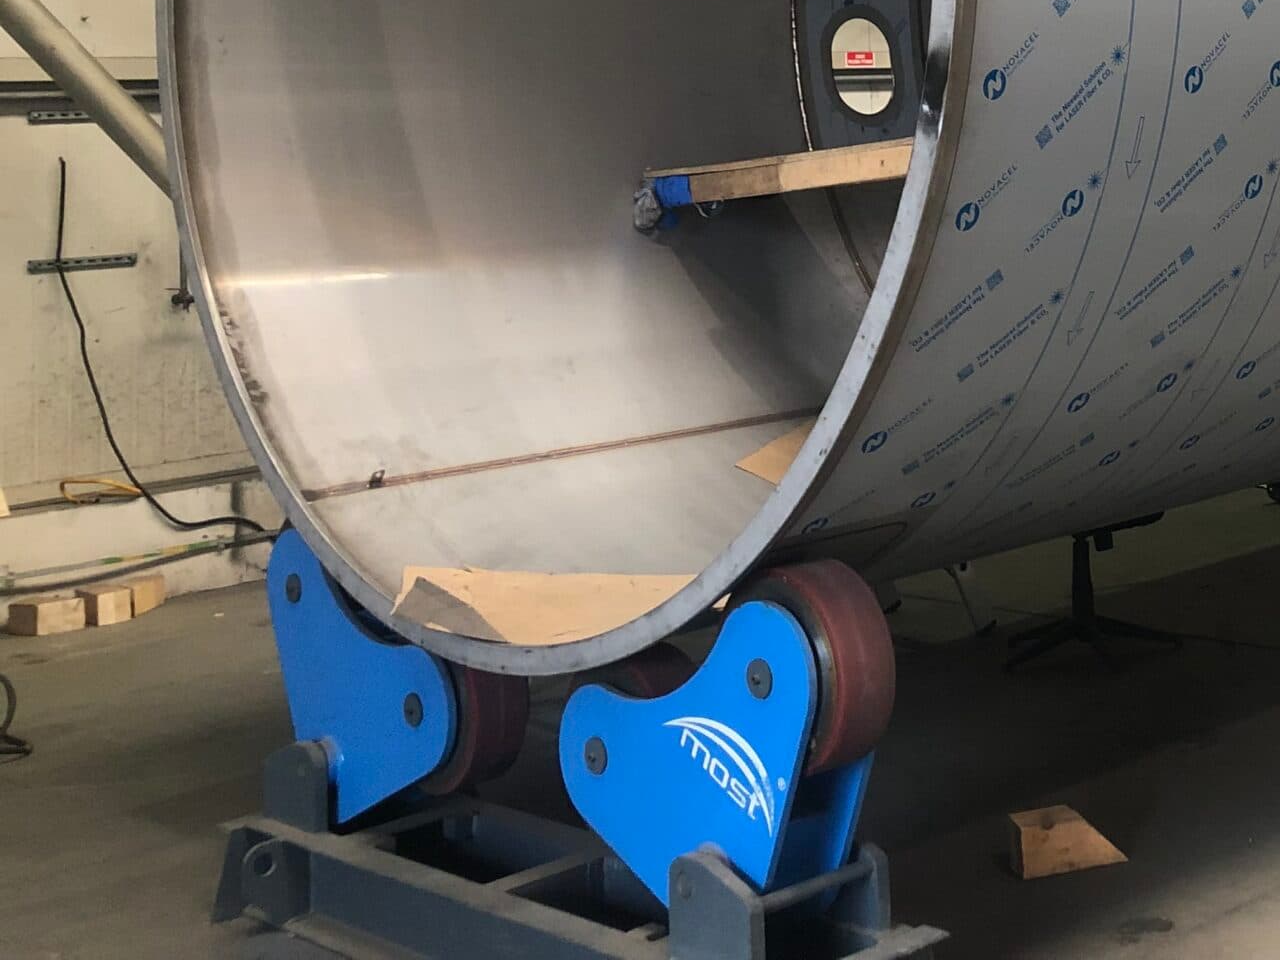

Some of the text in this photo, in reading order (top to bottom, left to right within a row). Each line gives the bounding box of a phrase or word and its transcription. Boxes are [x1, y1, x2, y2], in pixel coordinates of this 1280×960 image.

[1002, 32, 1040, 72] NOVACEL
[1201, 32, 1231, 68] NOVACEL
[977, 164, 1018, 205] NOVACEL
